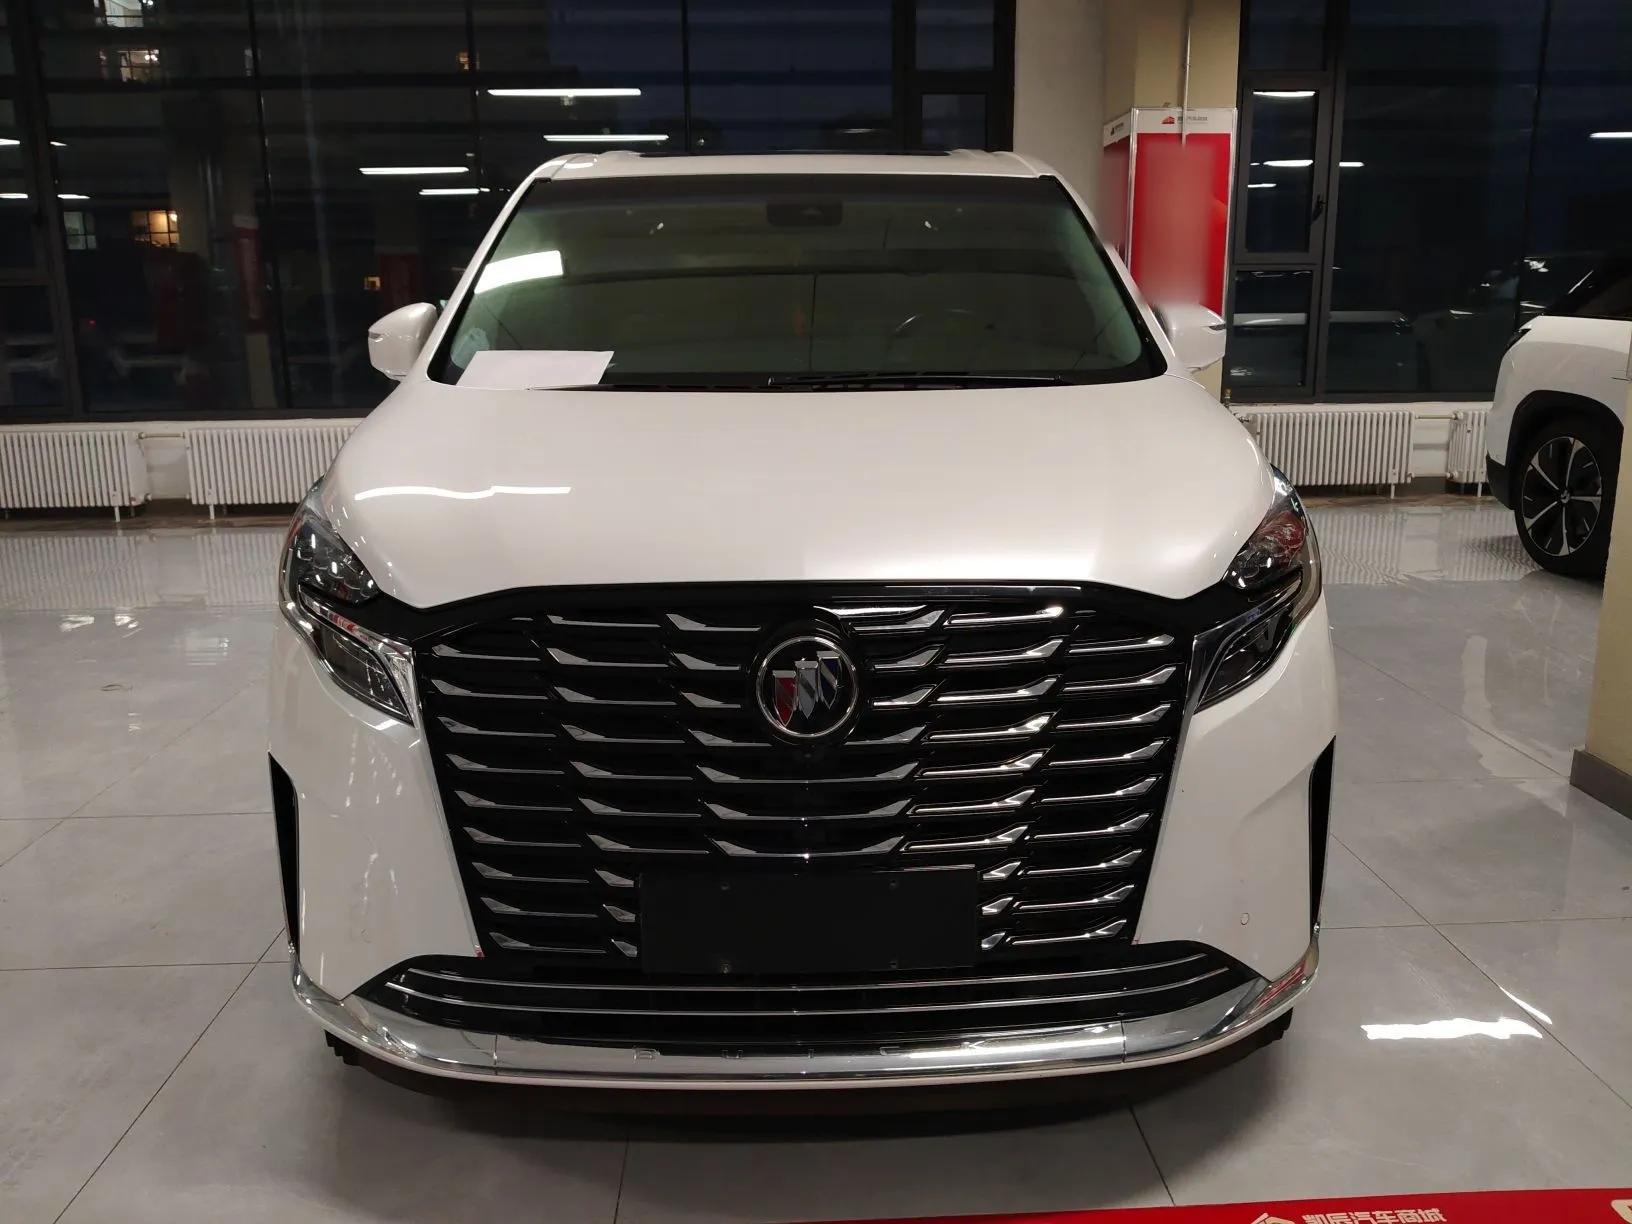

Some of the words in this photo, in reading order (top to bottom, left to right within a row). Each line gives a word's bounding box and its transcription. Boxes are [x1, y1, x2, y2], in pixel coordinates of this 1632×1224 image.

[1302, 1208, 1447, 1224] 凯辰汽车商城
